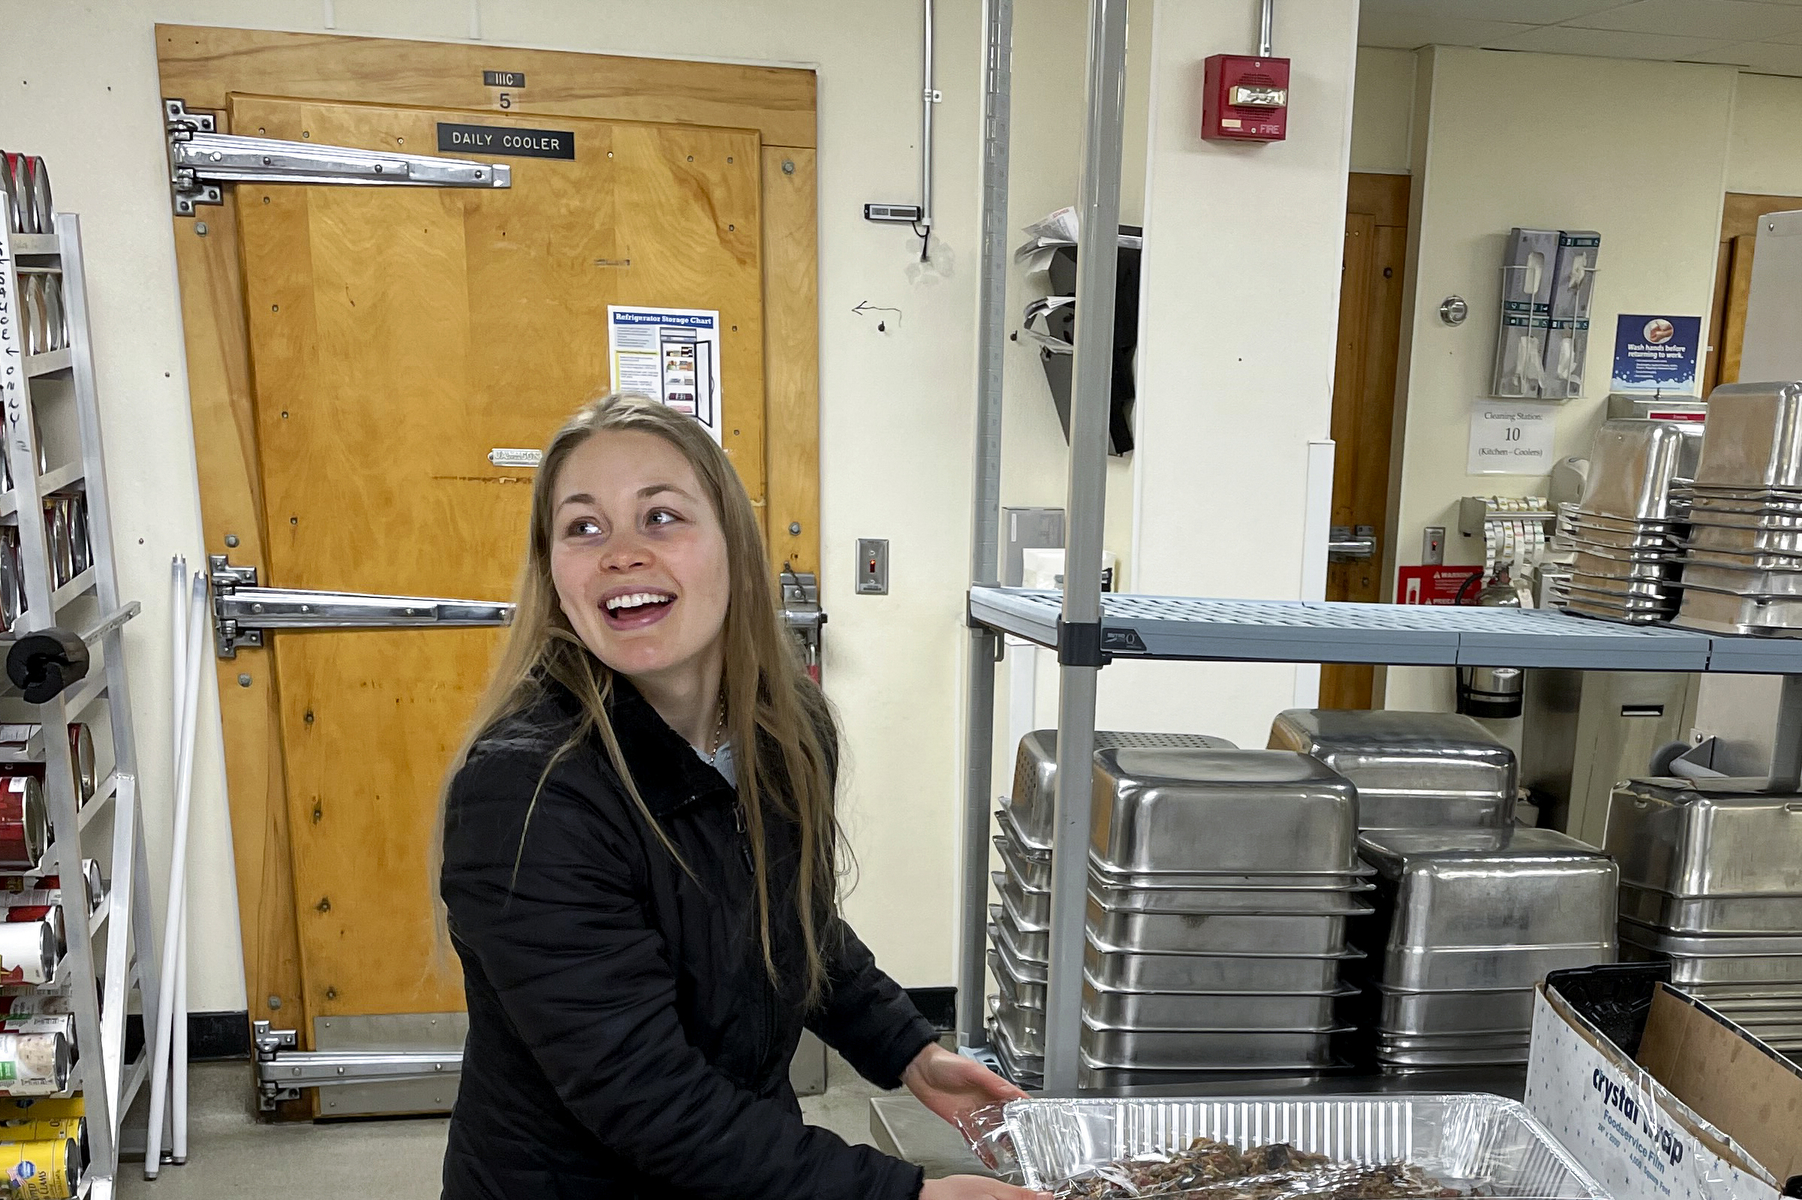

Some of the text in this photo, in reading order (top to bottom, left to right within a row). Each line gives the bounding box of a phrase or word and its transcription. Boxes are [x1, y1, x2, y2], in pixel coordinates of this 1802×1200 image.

[499, 93, 511, 109] 5
[1260, 124, 1280, 134] FIRE
[452, 131, 560, 150] DAILY COOLER
[616, 313, 712, 325] Refrigerator Storage Chart
[1627, 351, 1658, 359] returning
[1484, 412, 1543, 422] Cleaning Station:
[1505, 427, 1521, 441] 10
[1592, 1068, 1640, 1125] crystal
[1603, 1109, 1665, 1175] Foodservice Film
[38, 1170, 49, 1195] CLAMS
[1643, 1165, 1659, 1186] Square
